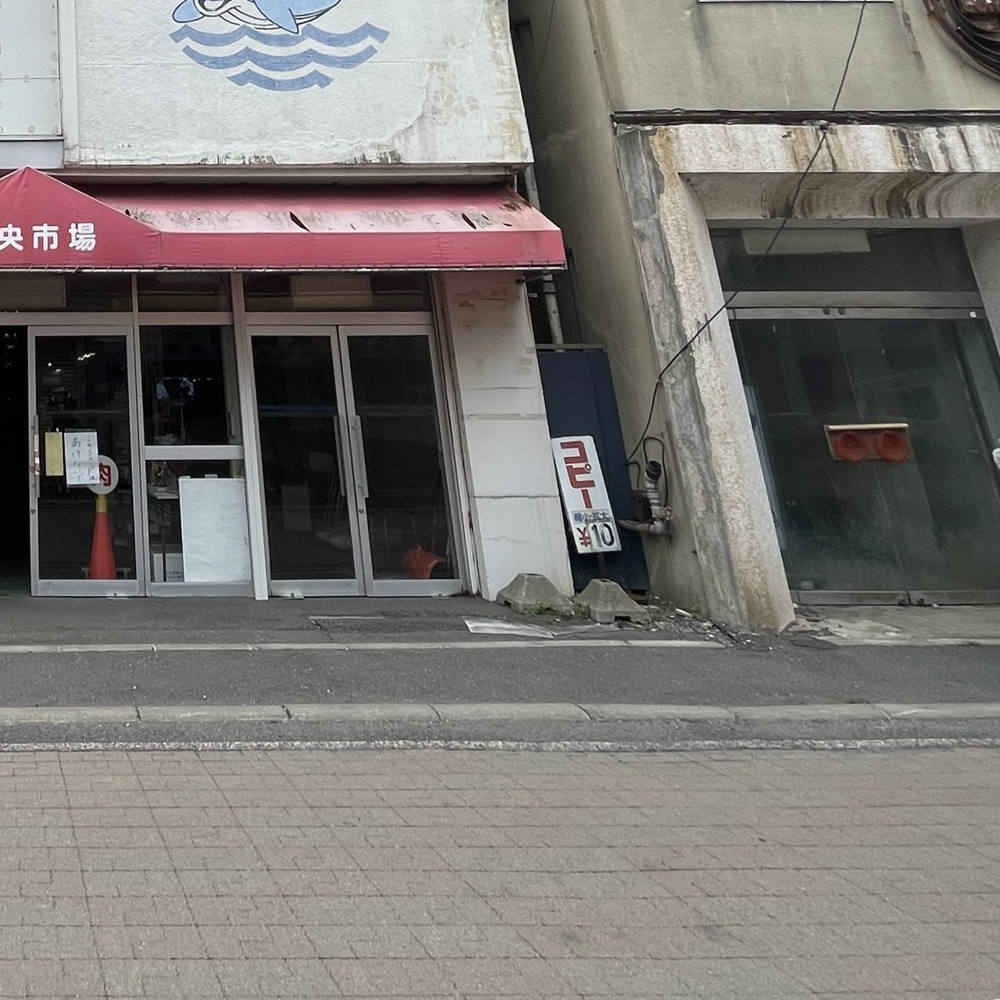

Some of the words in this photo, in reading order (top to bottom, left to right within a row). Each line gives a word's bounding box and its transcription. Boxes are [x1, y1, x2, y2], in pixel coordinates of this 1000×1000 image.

[560, 440, 596, 509] コピー
[576, 523, 615, 547] ¥10
